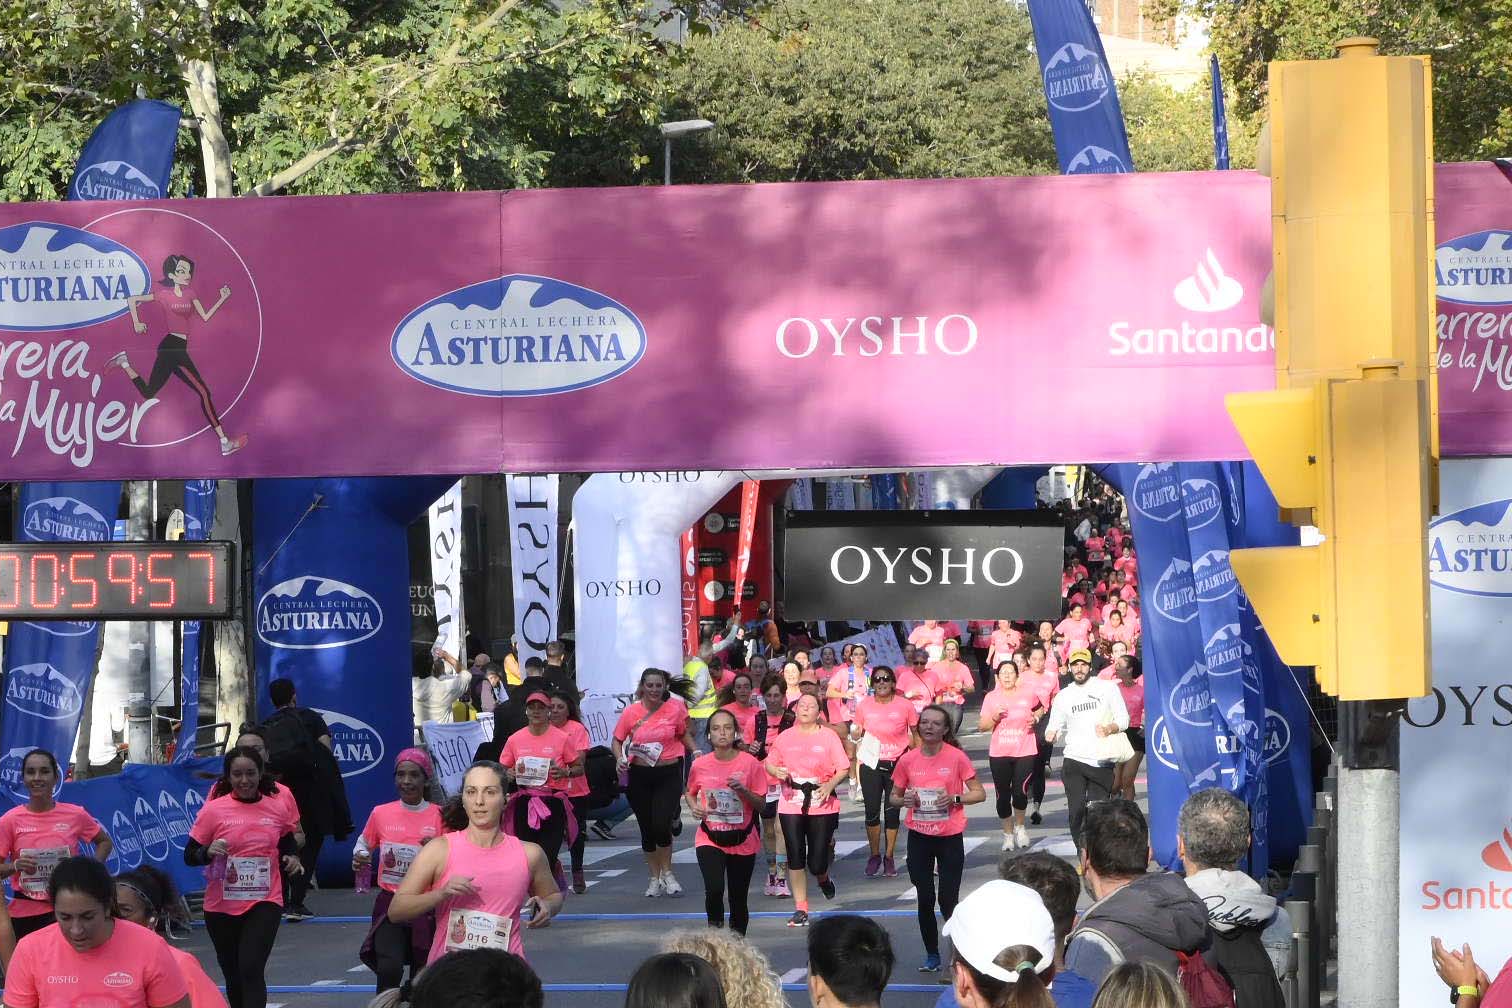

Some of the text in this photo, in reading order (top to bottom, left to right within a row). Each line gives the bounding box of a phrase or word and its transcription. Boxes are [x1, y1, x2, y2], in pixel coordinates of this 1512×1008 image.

[52, 258, 126, 270] LECHERA
[450, 314, 618, 331] CENTRAL LECHERA
[775, 314, 978, 359] OYSHO
[1436, 312, 1512, 340] arrer
[411, 322, 627, 366] ASTURIANA
[1109, 321, 1276, 356] Santand
[1459, 341, 1476, 369] la
[12, 373, 161, 468] Mujer
[26, 508, 105, 541] ASTURIANA
[830, 545, 1024, 587] OYSHO
[586, 578, 662, 599] OYSHO
[260, 605, 374, 632] ASTURIANA
[273, 600, 369, 610] CENTRAL LECHERA
[6, 677, 74, 711] ASTURIANA
[1402, 683, 1512, 729] OYS
[333, 732, 370, 740] CHERA
[1422, 881, 1512, 911] Santa
[467, 933, 489, 944] 016
